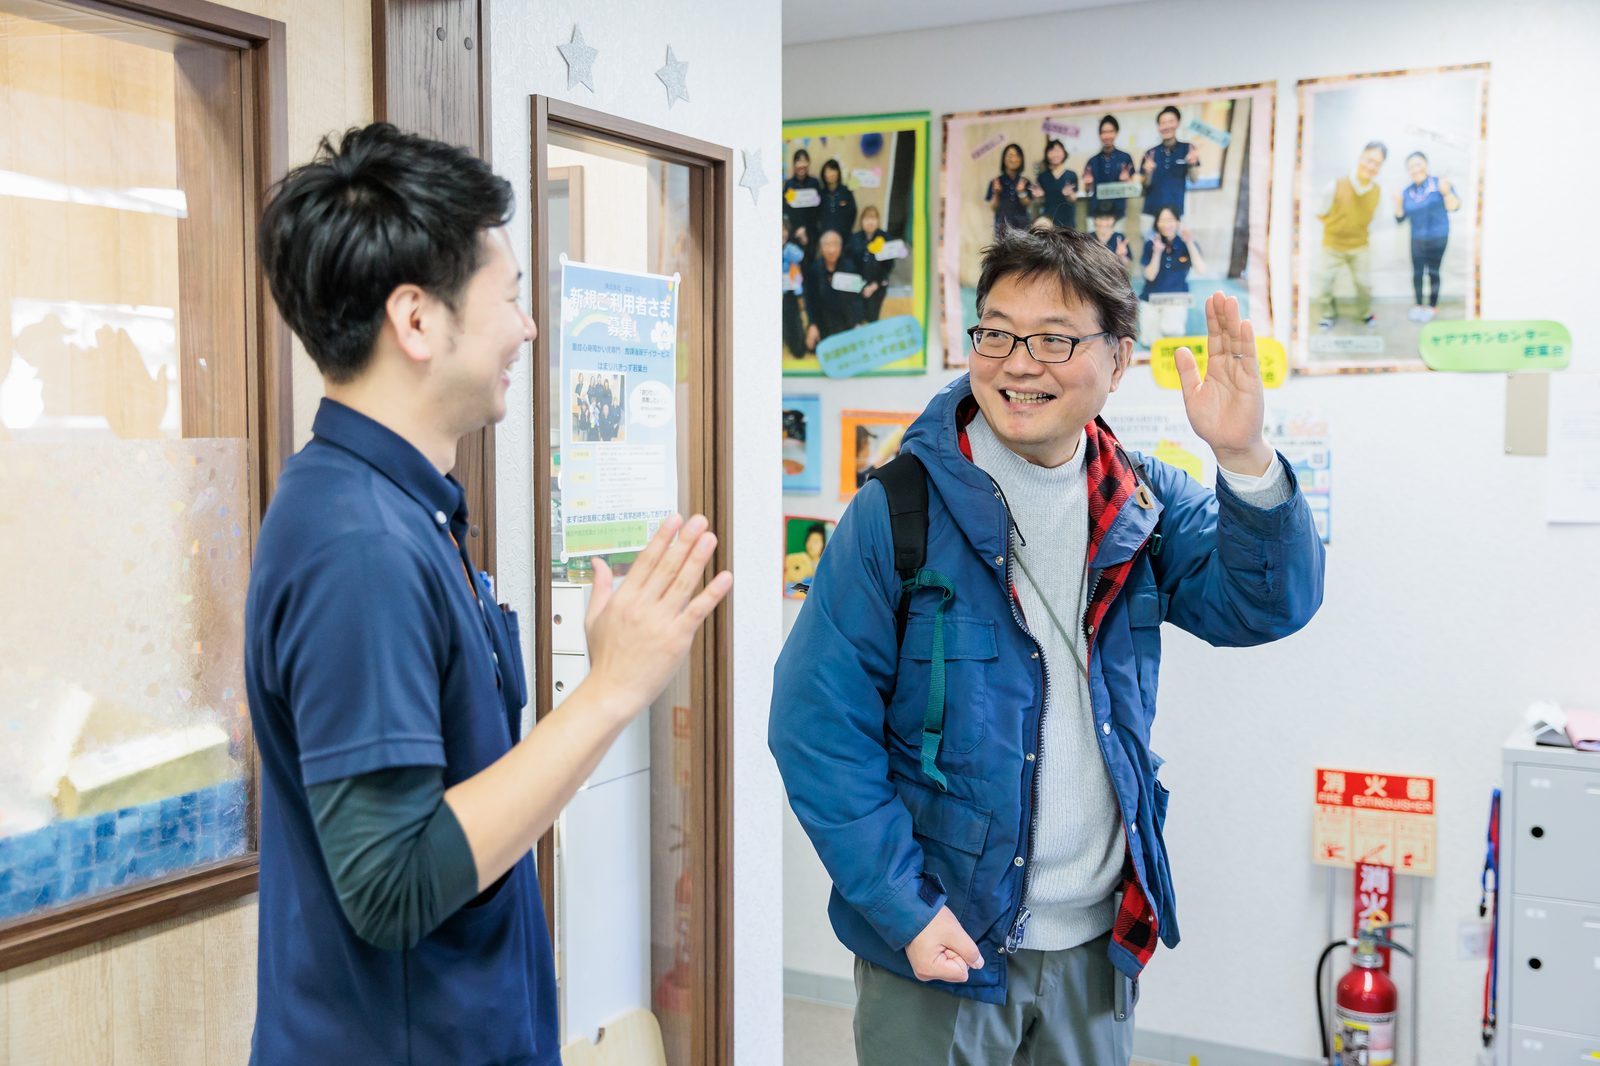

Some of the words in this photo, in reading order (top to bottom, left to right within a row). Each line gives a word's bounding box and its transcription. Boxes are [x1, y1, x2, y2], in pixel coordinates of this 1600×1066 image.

[569, 287, 672, 319] 新規ご利用者さま
[607, 315, 634, 338] 募集
[1431, 328, 1551, 346] ケアプランセンター
[1322, 770, 1431, 801] 消火器
[1317, 790, 1344, 806] FIRE
[1352, 794, 1433, 814] EXTINGUISHER
